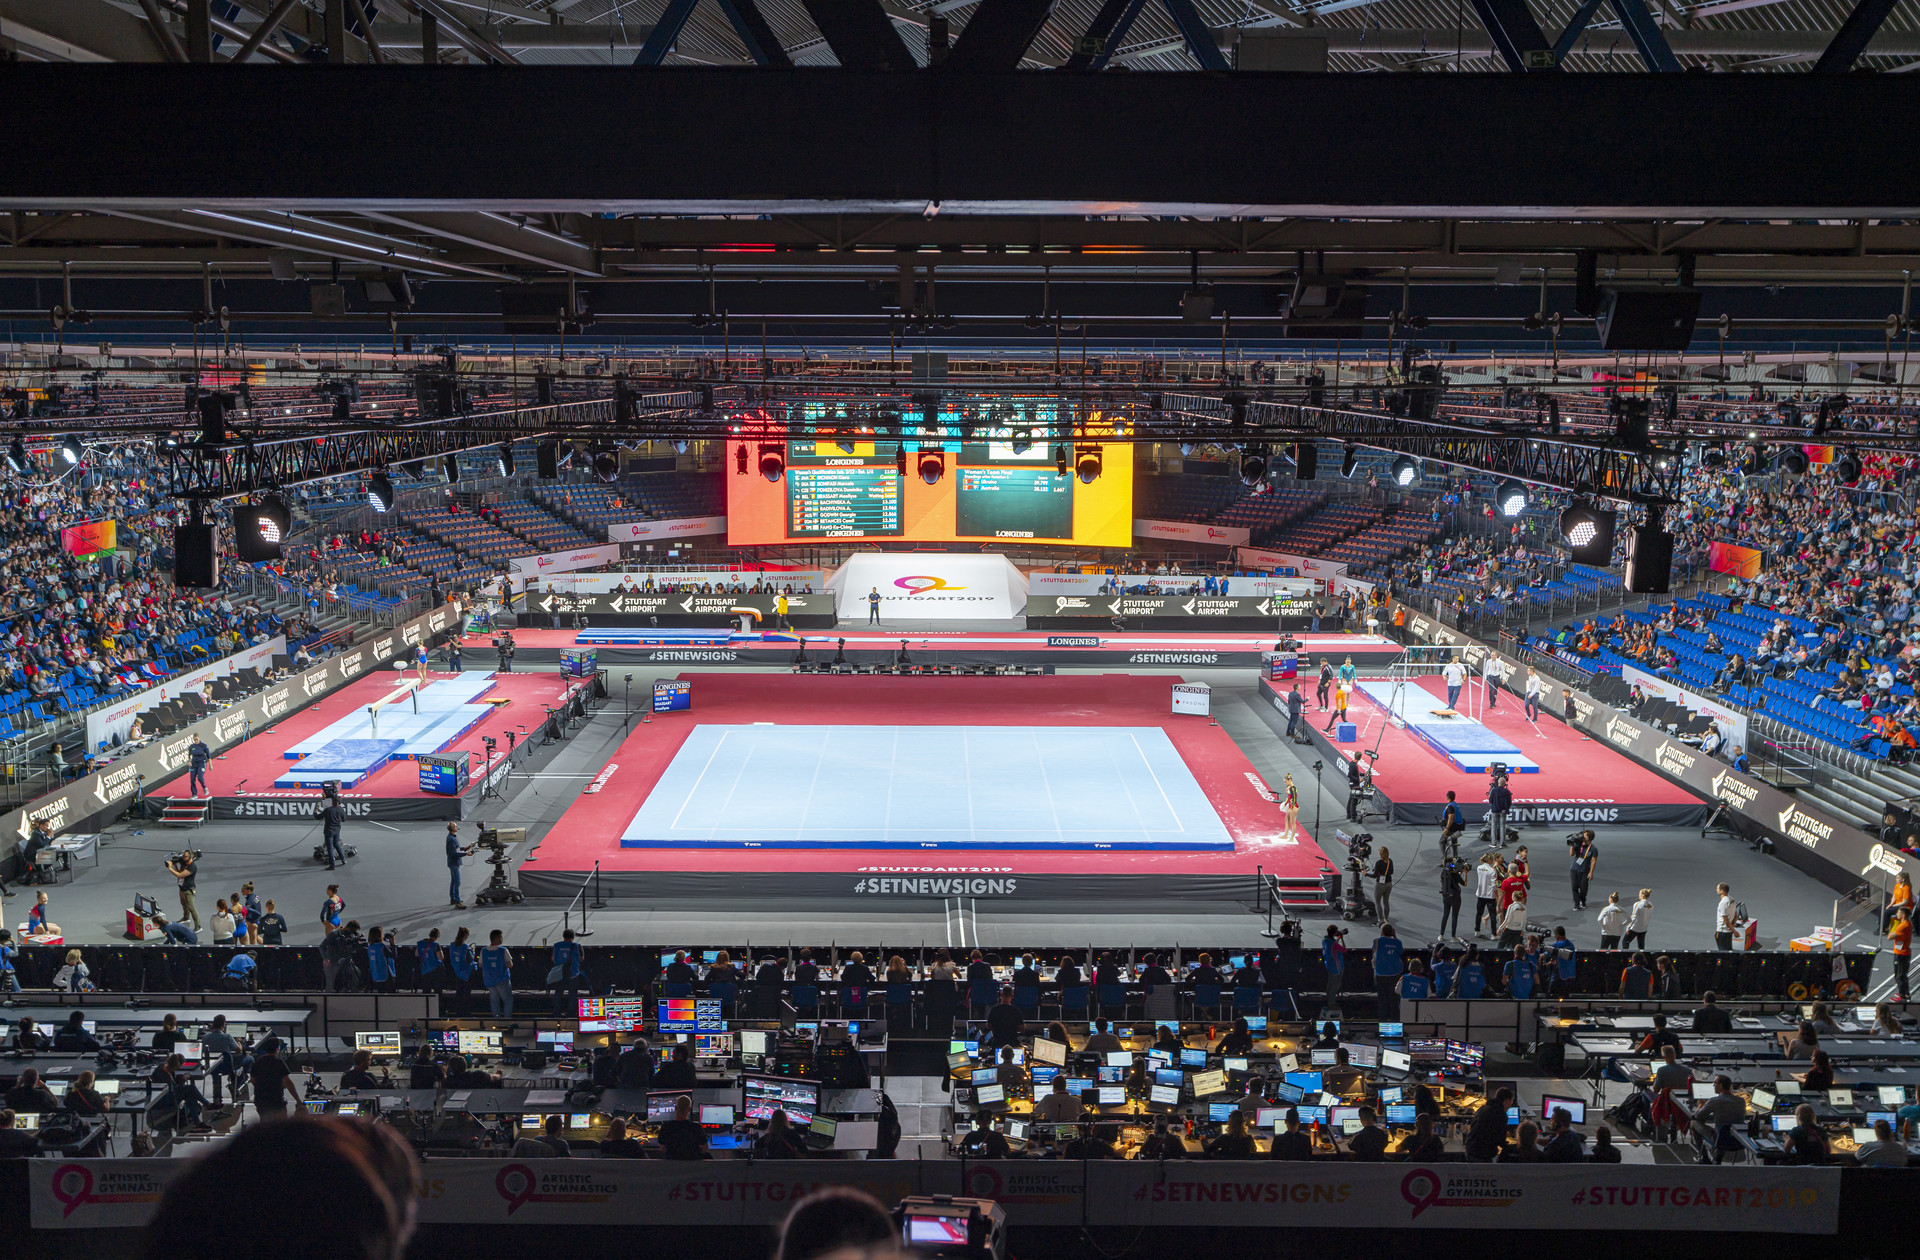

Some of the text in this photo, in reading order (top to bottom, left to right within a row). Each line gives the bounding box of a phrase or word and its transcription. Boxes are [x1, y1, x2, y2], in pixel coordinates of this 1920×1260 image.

[995, 530, 1034, 538] LONGINES
[695, 598, 737, 606] STUTTGART
[1122, 600, 1165, 608] STUTTGART
[1197, 608, 1229, 616] AIRPORT
[1050, 638, 1097, 646] LONGINES
[649, 652, 738, 661] #SETNEWSIGNS
[1130, 654, 1218, 664] #SETNEWSIGNS
[307, 668, 329, 684] STUTTGART
[310, 680, 327, 695] AIRPORT
[654, 682, 690, 690] LONGINES
[1172, 686, 1210, 694] LONGINES
[267, 688, 290, 706] STUTTGART
[106, 702, 143, 724] #STUTTGART2019
[270, 701, 288, 717] AIRPORT
[1700, 706, 1736, 726] #STUTTGART2019
[220, 710, 246, 730] STUTTGART
[224, 722, 244, 741] AIRPORT
[1614, 720, 1642, 740] STUTTGART
[1611, 731, 1632, 748] AIRPORT
[418, 756, 456, 768] LONGINES
[1666, 746, 1696, 768] STUTTGART
[1662, 758, 1685, 776] AIRPORT
[104, 764, 137, 788] STUTTGART
[108, 781, 135, 801] AIRPORT
[1722, 776, 1759, 801] STUTTGART
[30, 796, 69, 821] STUTTGART
[1482, 808, 1618, 822] #ETNEWSIGNS
[1792, 811, 1834, 840] STUTTGART
[1787, 824, 1820, 849] AIRPORT
[854, 878, 1017, 894] #SETNEWSIGNS
[100, 1173, 150, 1182] ARTISTIC
[542, 1174, 592, 1183] ARTISTIC
[1009, 1175, 1059, 1184] ARTISTIC
[1448, 1179, 1498, 1188] ARTISTIC
[541, 1183, 618, 1194] GYMNASTICS
[1008, 1184, 1085, 1194] GYMNASTICS
[1133, 1182, 1351, 1202] #SETNEWSIGNS
[1446, 1188, 1523, 1198] GYMNASTICS
[1572, 1186, 1817, 1207] #STUTTGART2019
